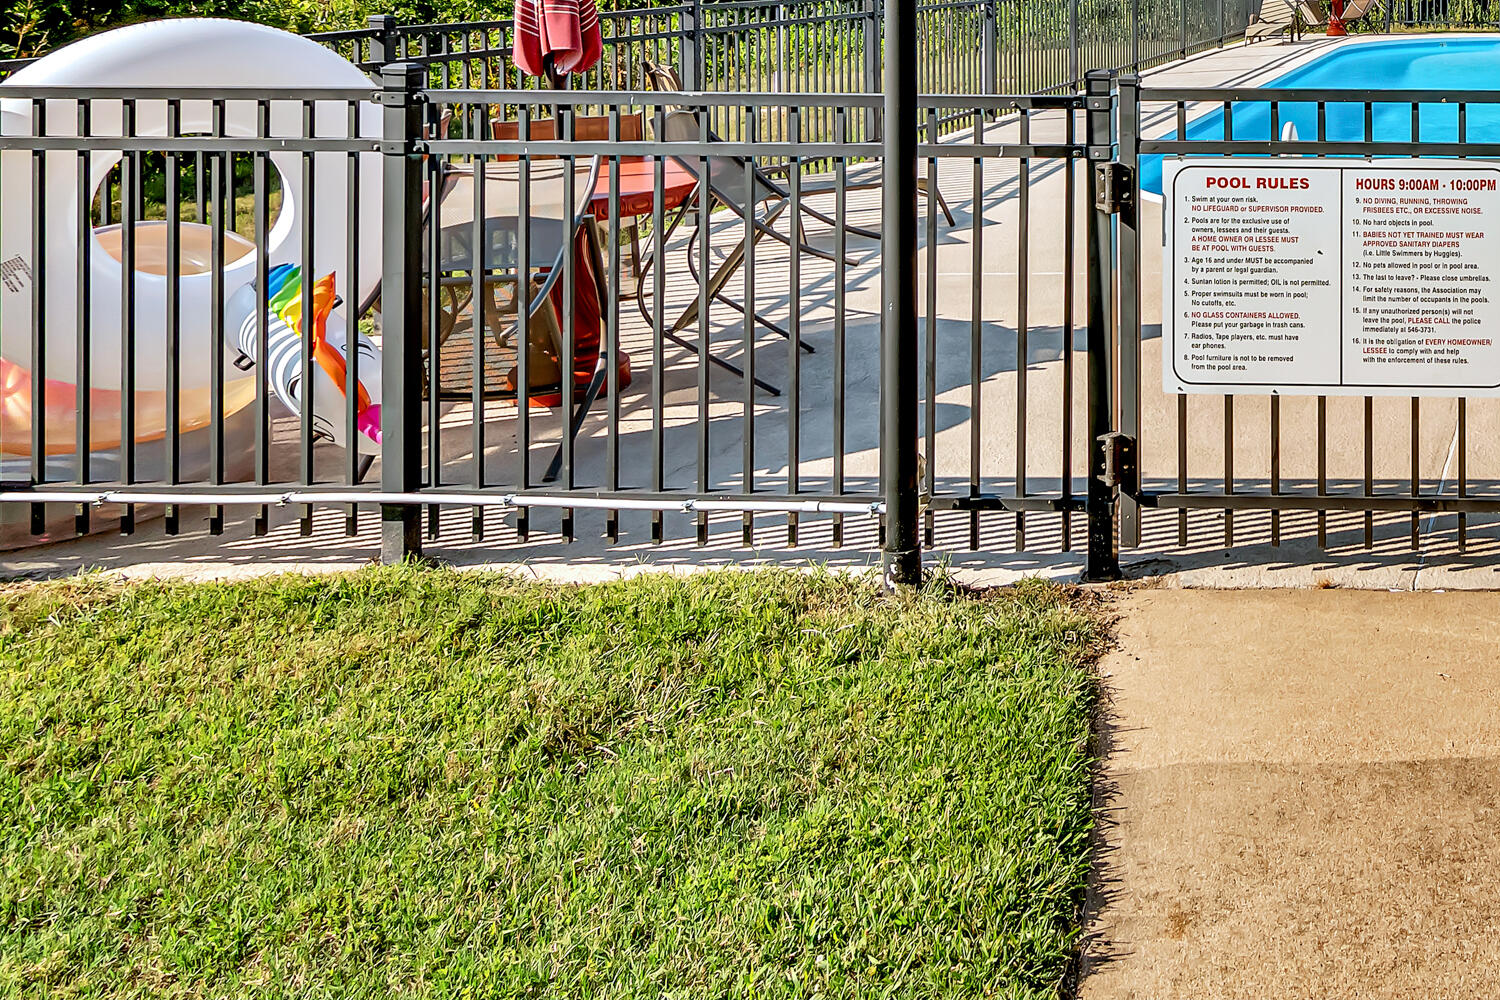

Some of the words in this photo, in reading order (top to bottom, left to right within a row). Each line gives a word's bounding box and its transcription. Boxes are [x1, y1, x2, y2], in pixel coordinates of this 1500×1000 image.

[1206, 176, 1250, 188] POOL
[1256, 177, 1309, 189] RULES
[1355, 178, 1395, 190] HOURS
[1398, 178, 1439, 190] 9:00AM
[1449, 179, 1496, 190] 10:00PM
[1388, 219, 1410, 227] objects
[1424, 250, 1432, 258] by
[1191, 256, 1203, 264] Age
[1273, 257, 1313, 265] accompanied
[1233, 266, 1249, 274] legal
[1419, 262, 1433, 270] pool
[1448, 262, 1463, 270] pool
[1191, 290, 1211, 298] Proper
[1239, 321, 1264, 329] garbage
[1362, 325, 1399, 334] immediately
